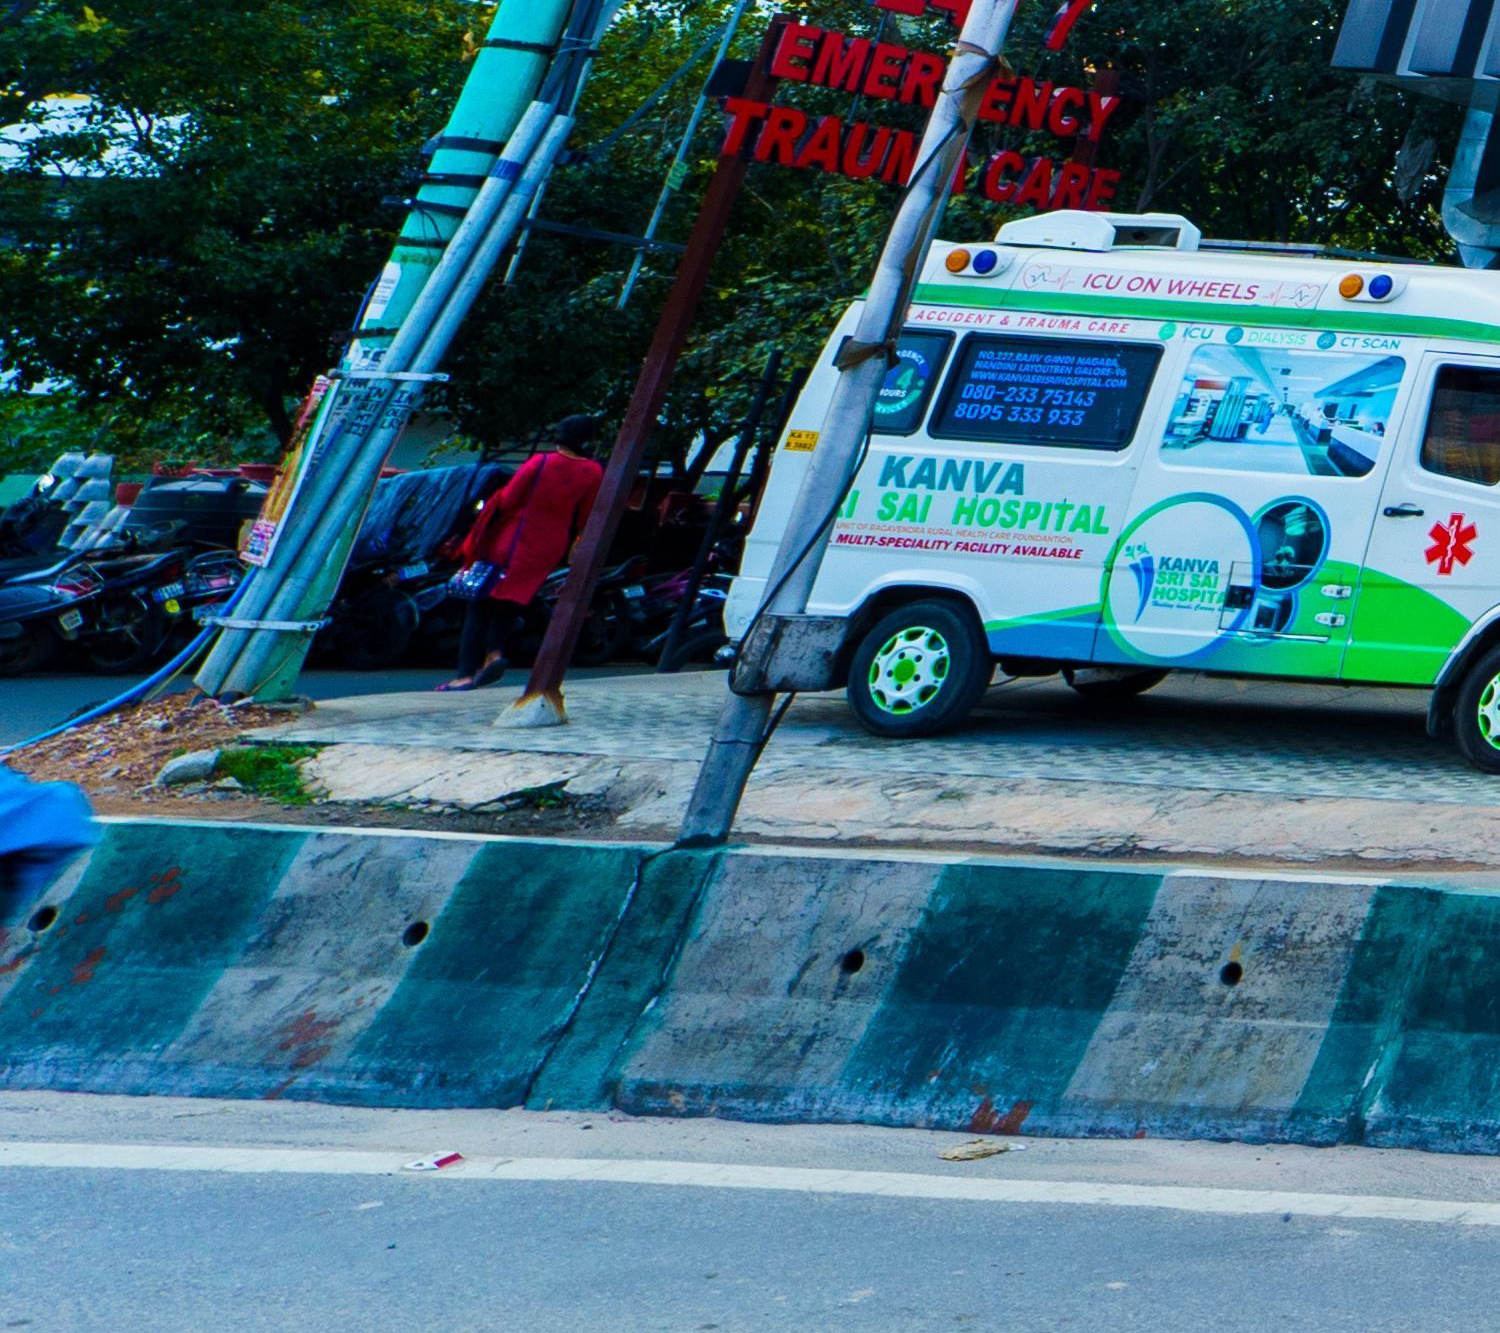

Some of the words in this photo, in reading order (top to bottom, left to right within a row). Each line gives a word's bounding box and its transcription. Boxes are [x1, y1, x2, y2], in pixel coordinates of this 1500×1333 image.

[771, 21, 1121, 143] EMERENCY
[984, 150, 1122, 212] CARE
[1082, 272, 1125, 291] ICU
[1126, 275, 1162, 295] ON
[1166, 279, 1260, 301] WHEELS
[914, 309, 995, 325] ACCIDENT
[999, 315, 1010, 326] &
[1016, 316, 1081, 331] TRAUMA
[1087, 320, 1132, 334] CARE
[1182, 325, 1215, 341] ICU
[1247, 330, 1309, 346] DIALYSIS
[1340, 336, 1360, 349] CT
[1362, 337, 1401, 351] SCAN
[1041, 388, 1097, 408] 75143
[954, 402, 1006, 421] 8095
[1007, 405, 1045, 425] 333
[1047, 409, 1087, 427] 933
[876, 454, 1026, 496] KANVA
[875, 490, 934, 524] SAI
[950, 496, 1110, 535] HOSPITAL
[835, 533, 953, 551] MULTI-SPECIALITY
[953, 540, 1011, 555] FACILITY
[1011, 544, 1085, 560] AVAILABLE
[1158, 555, 1219, 575] KANVA
[1155, 571, 1185, 585] SRI
[1188, 572, 1219, 589] SAI
